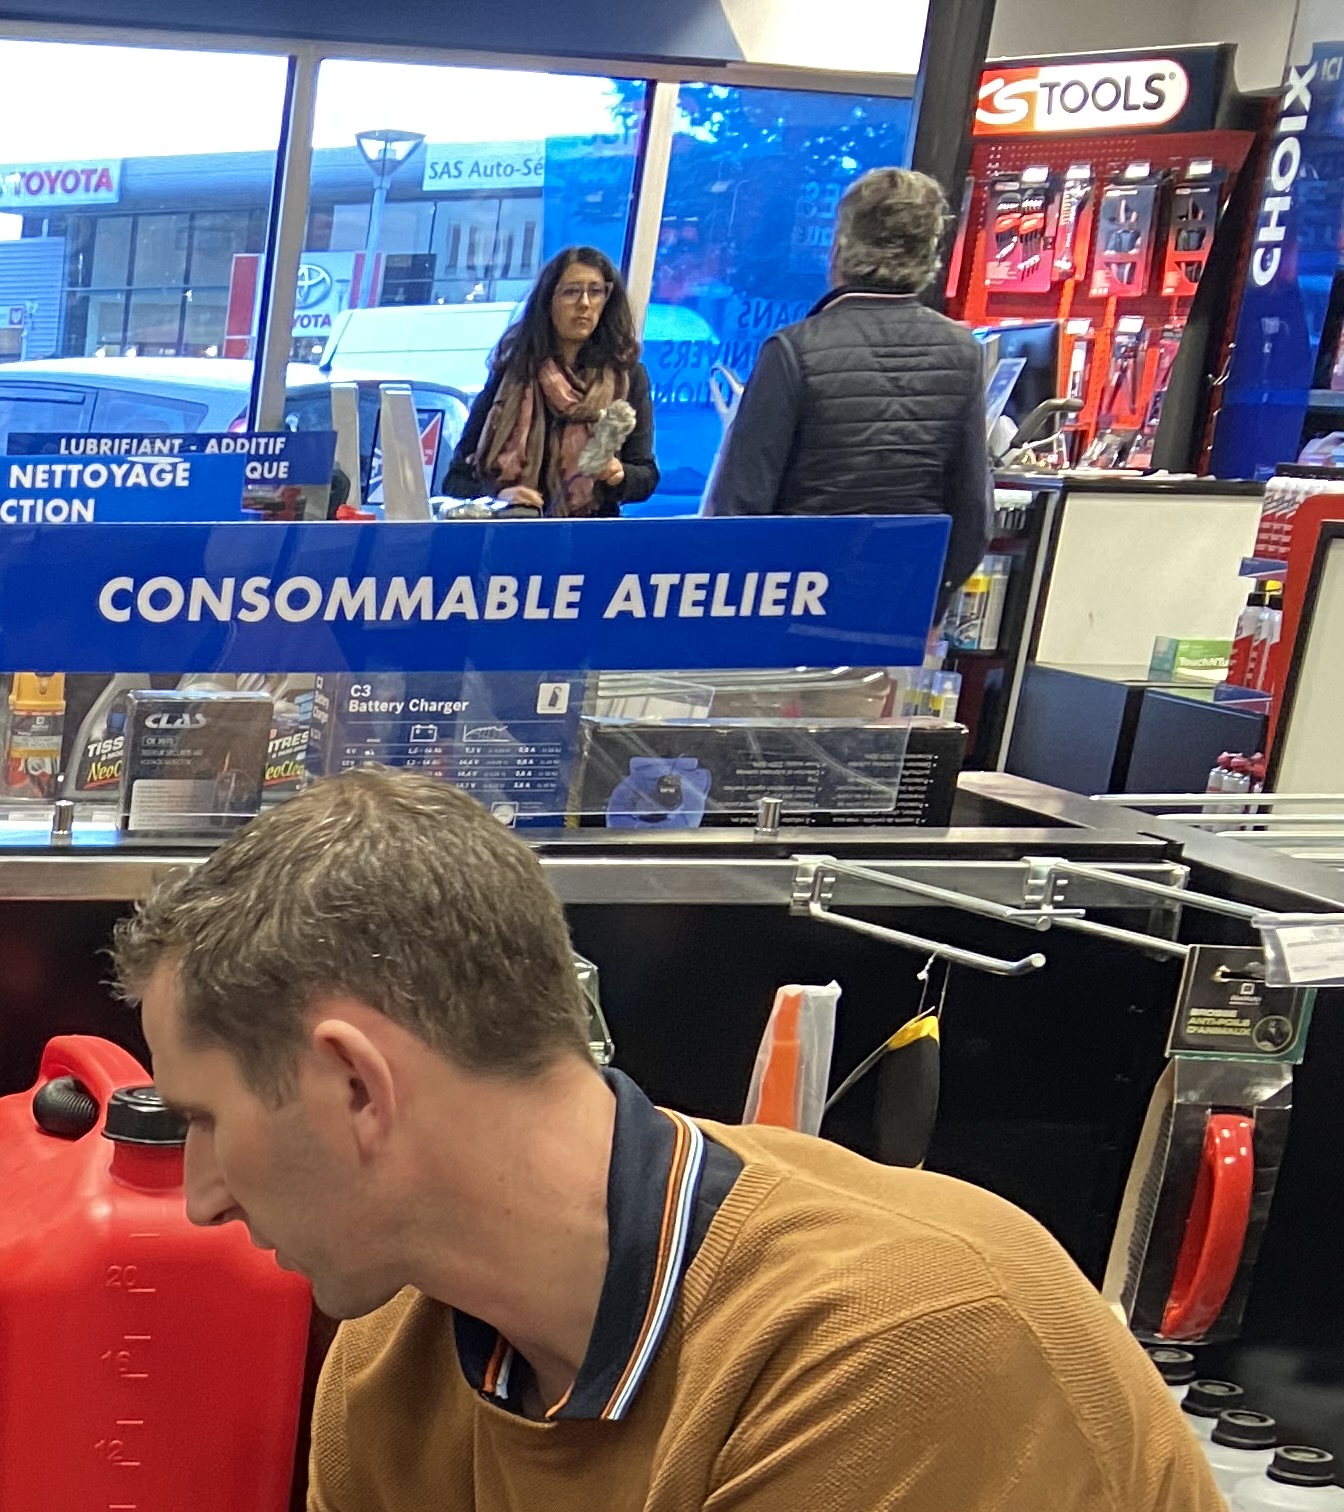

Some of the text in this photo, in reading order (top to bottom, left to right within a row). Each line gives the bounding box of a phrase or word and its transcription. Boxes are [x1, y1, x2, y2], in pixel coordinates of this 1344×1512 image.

[1039, 72, 1167, 115] TOOLS
[428, 161, 463, 180] SAS
[1252, 61, 1318, 286] CHOIX
[293, 313, 332, 329] YOTA
[59, 437, 182, 455] LUBRIFIANT
[205, 437, 286, 455] ADDITIF
[9, 461, 191, 488] NETTOYAGE
[99, 570, 830, 624] CONSOMMABLE ATELIER
[350, 684, 371, 697] C3
[348, 698, 469, 714] Battery Charger
[144, 713, 207, 729] CLAS
[87, 736, 124, 758] TISS
[87, 760, 121, 782] NeoC
